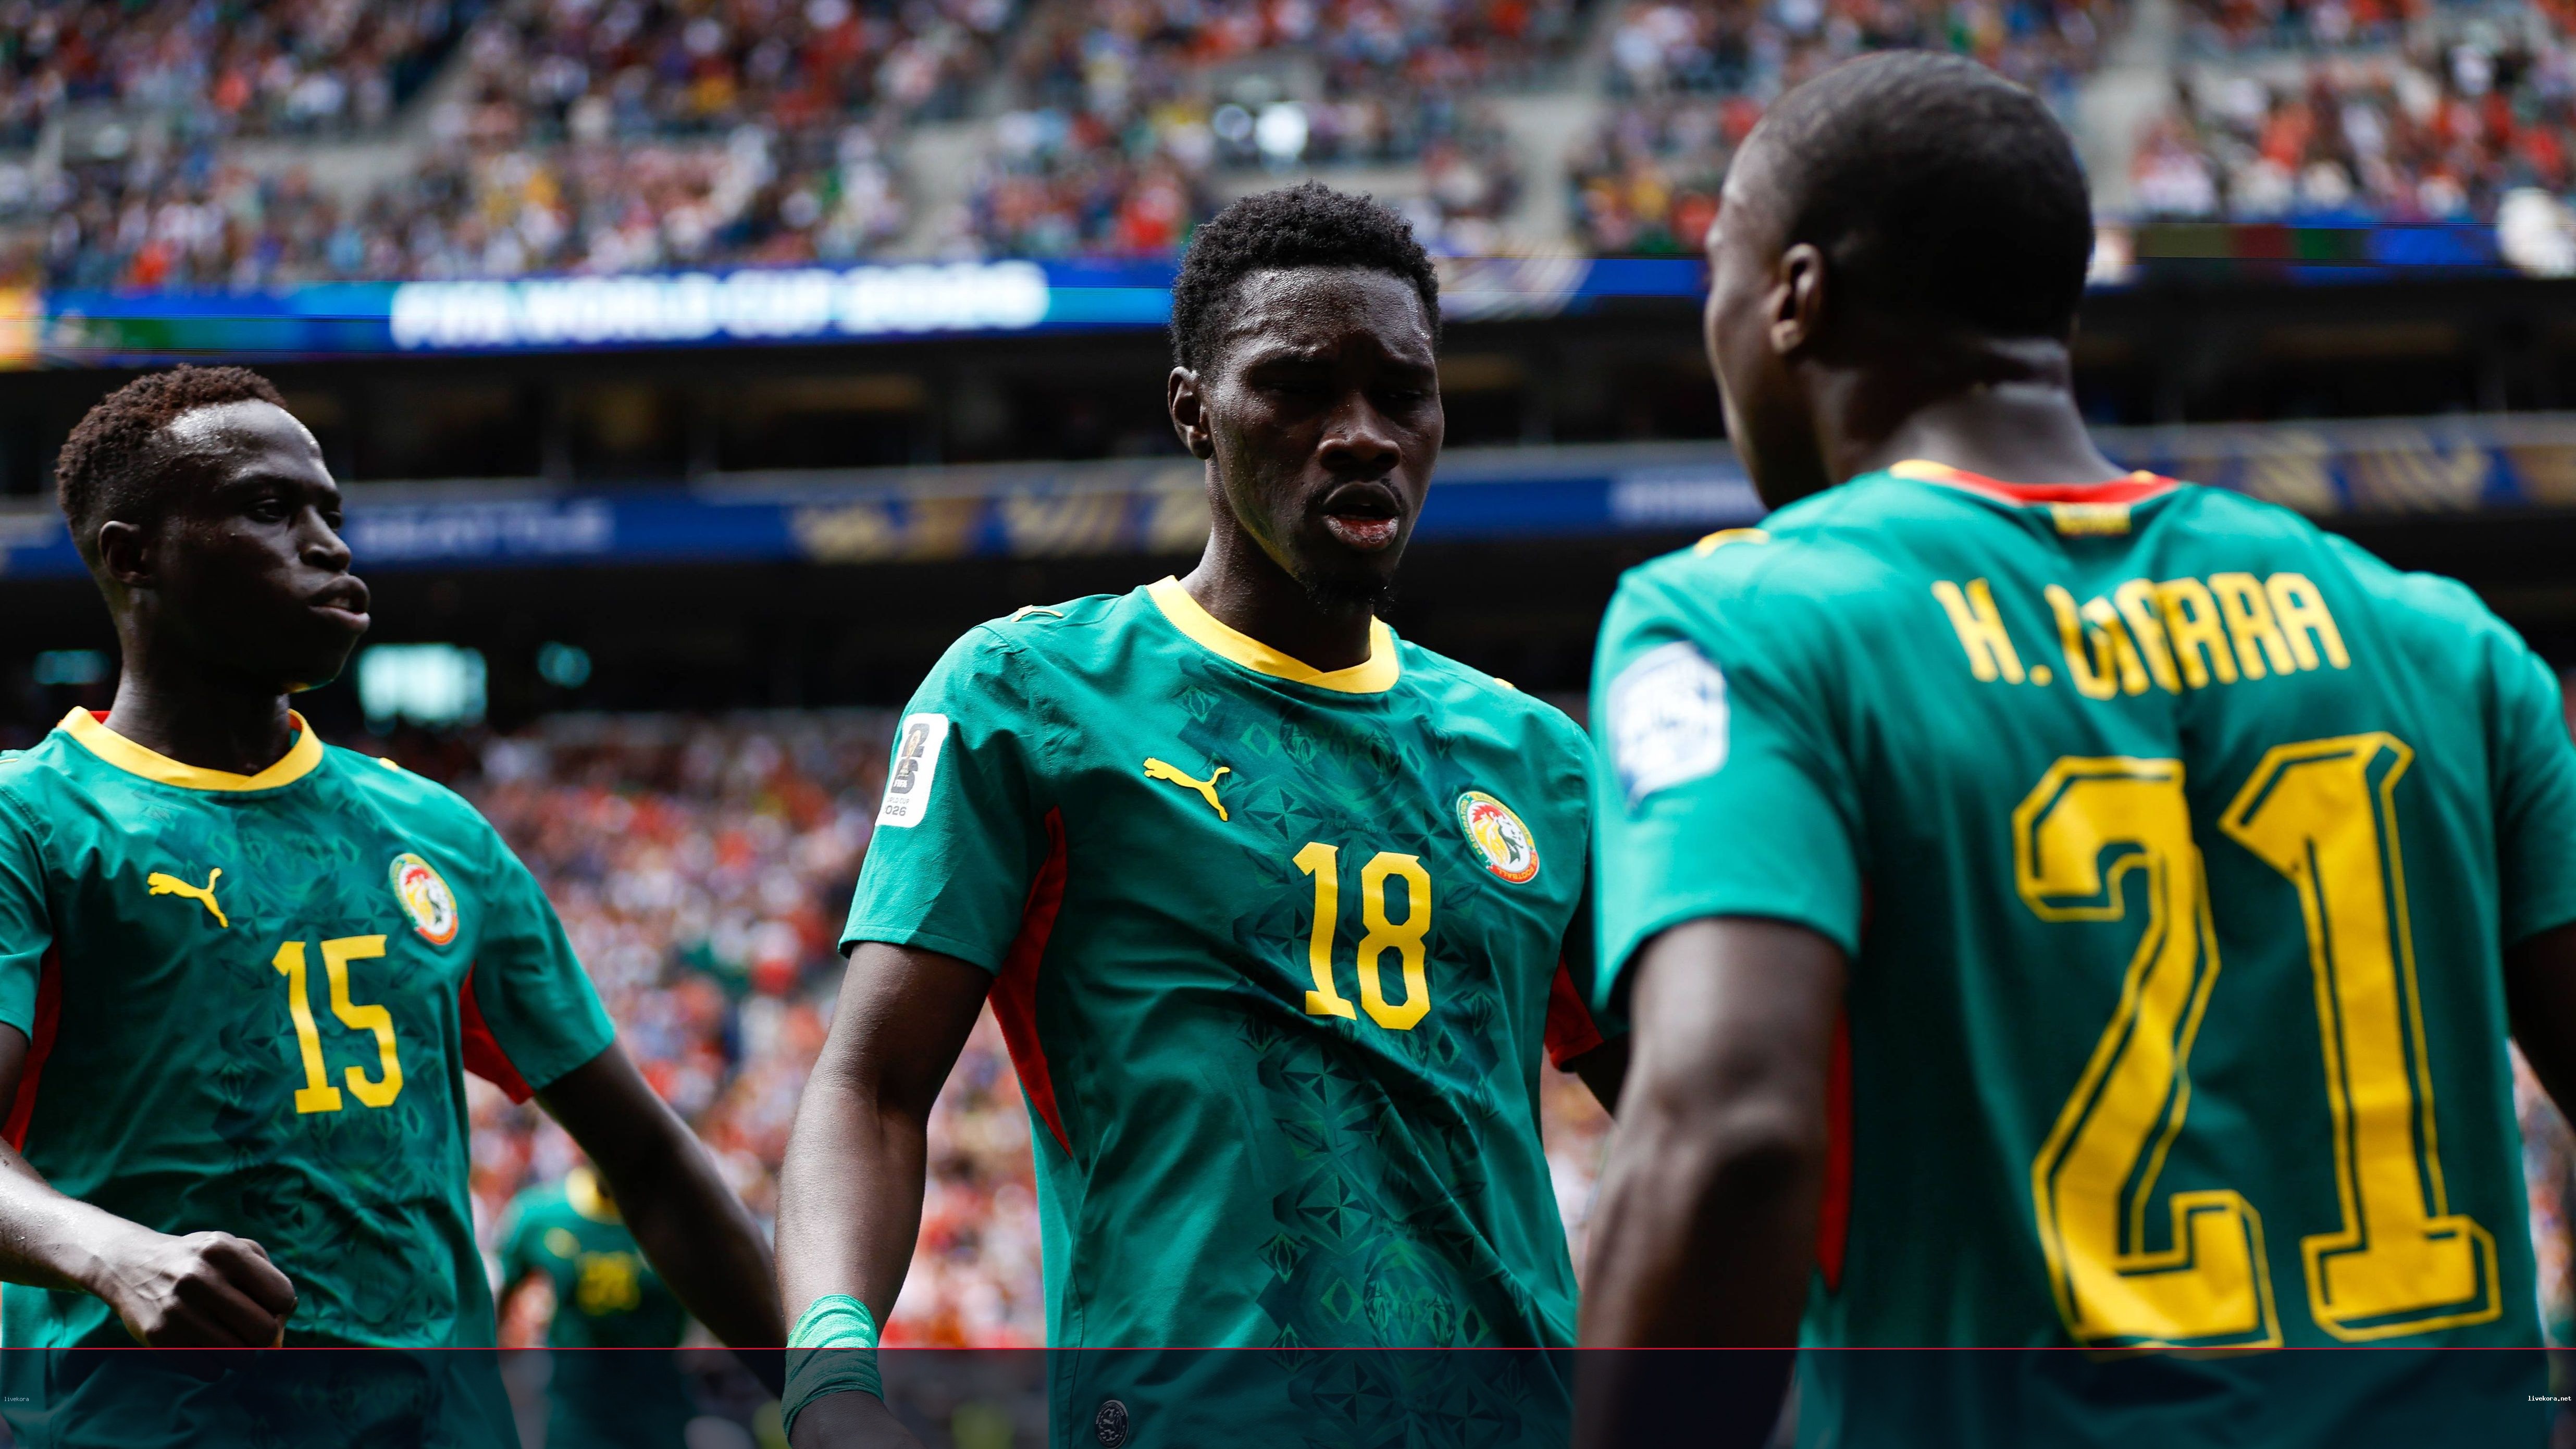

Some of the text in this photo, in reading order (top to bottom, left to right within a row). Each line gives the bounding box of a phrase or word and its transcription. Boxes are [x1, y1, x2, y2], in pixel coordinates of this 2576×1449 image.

[1930, 576, 2053, 687] H.
[1292, 841, 1431, 1030] 18
[1497, 865, 1534, 880] FOOTBALL
[271, 934, 403, 1113] 15
[2011, 731, 2501, 1351] 21
